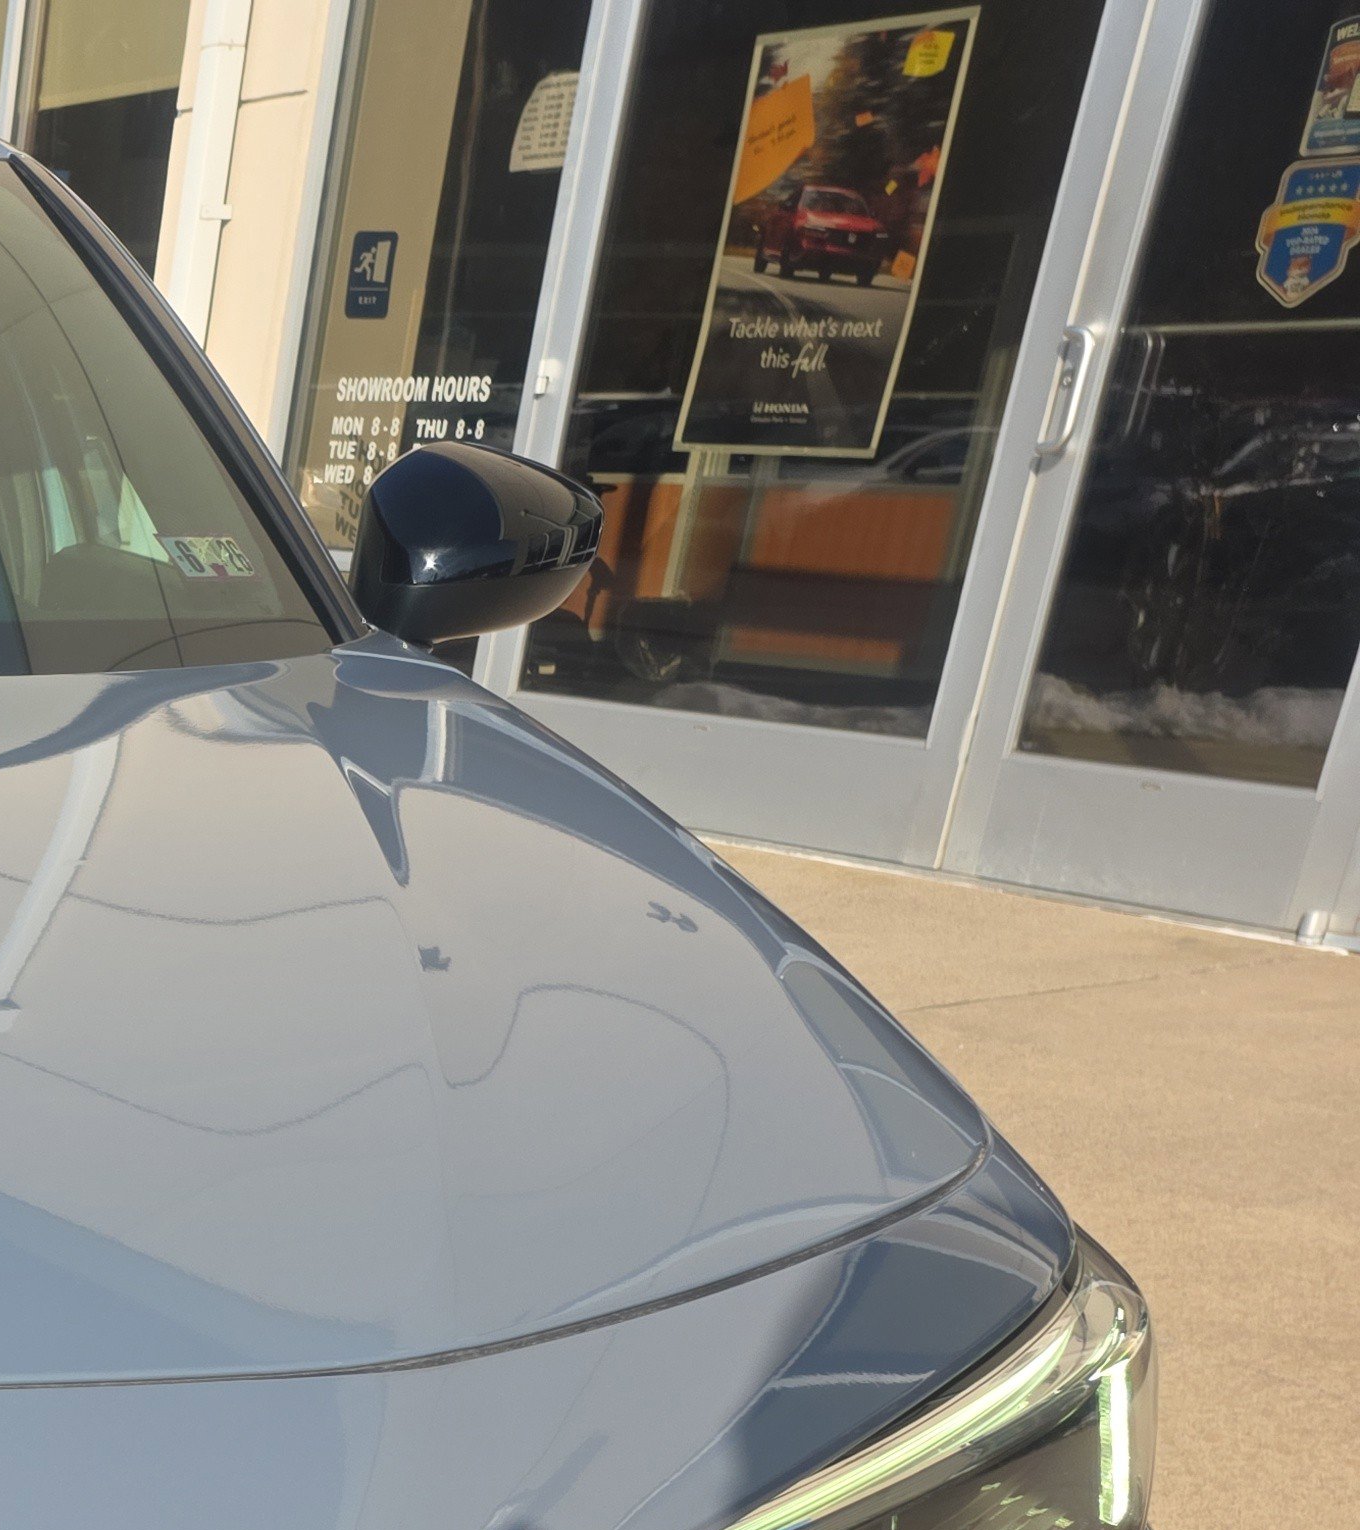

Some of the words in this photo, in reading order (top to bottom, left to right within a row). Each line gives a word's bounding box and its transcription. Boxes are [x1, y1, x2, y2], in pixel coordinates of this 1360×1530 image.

[358, 295, 378, 305] EXIT
[728, 316, 778, 339] Tackle
[783, 316, 837, 339] what's
[841, 318, 883, 339] next
[760, 346, 790, 370] this
[336, 375, 429, 403] SHOWROOM
[431, 375, 493, 403] HOURS
[764, 402, 809, 414] HONDA
[331, 416, 364, 436] MON
[416, 419, 449, 439] THU
[328, 440, 358, 460] TUE
[325, 465, 355, 484] WED
